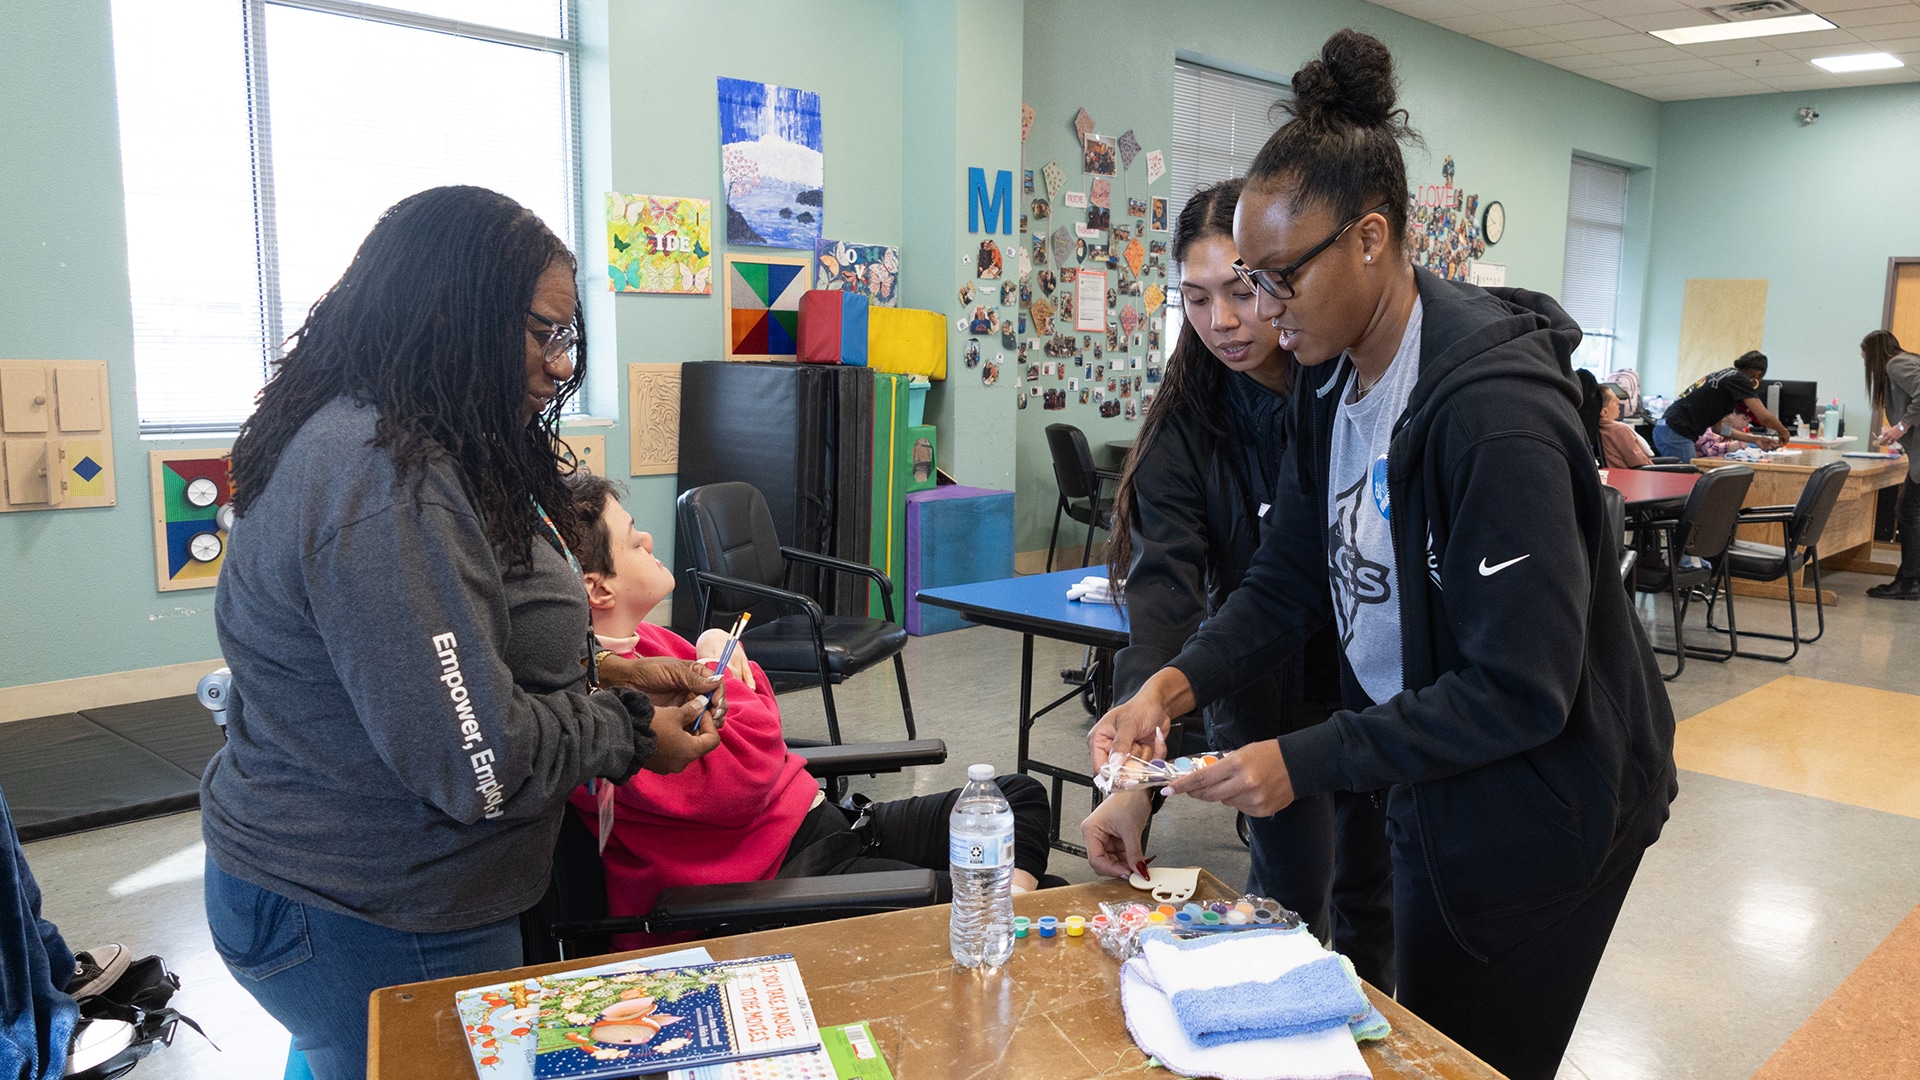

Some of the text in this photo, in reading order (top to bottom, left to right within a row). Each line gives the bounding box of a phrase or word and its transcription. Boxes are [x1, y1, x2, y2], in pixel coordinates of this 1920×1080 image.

[970, 168, 1012, 234] M
[1417, 185, 1457, 208] LOVE
[654, 233, 692, 253] IDE
[432, 631, 483, 750] Empower,
[759, 965, 778, 973] IF
[762, 974, 782, 987] YOU
[766, 987, 787, 1005] TAKE
[739, 987, 770, 1042] TO THE MOVIES
[772, 1012, 797, 1039] MOUSE
